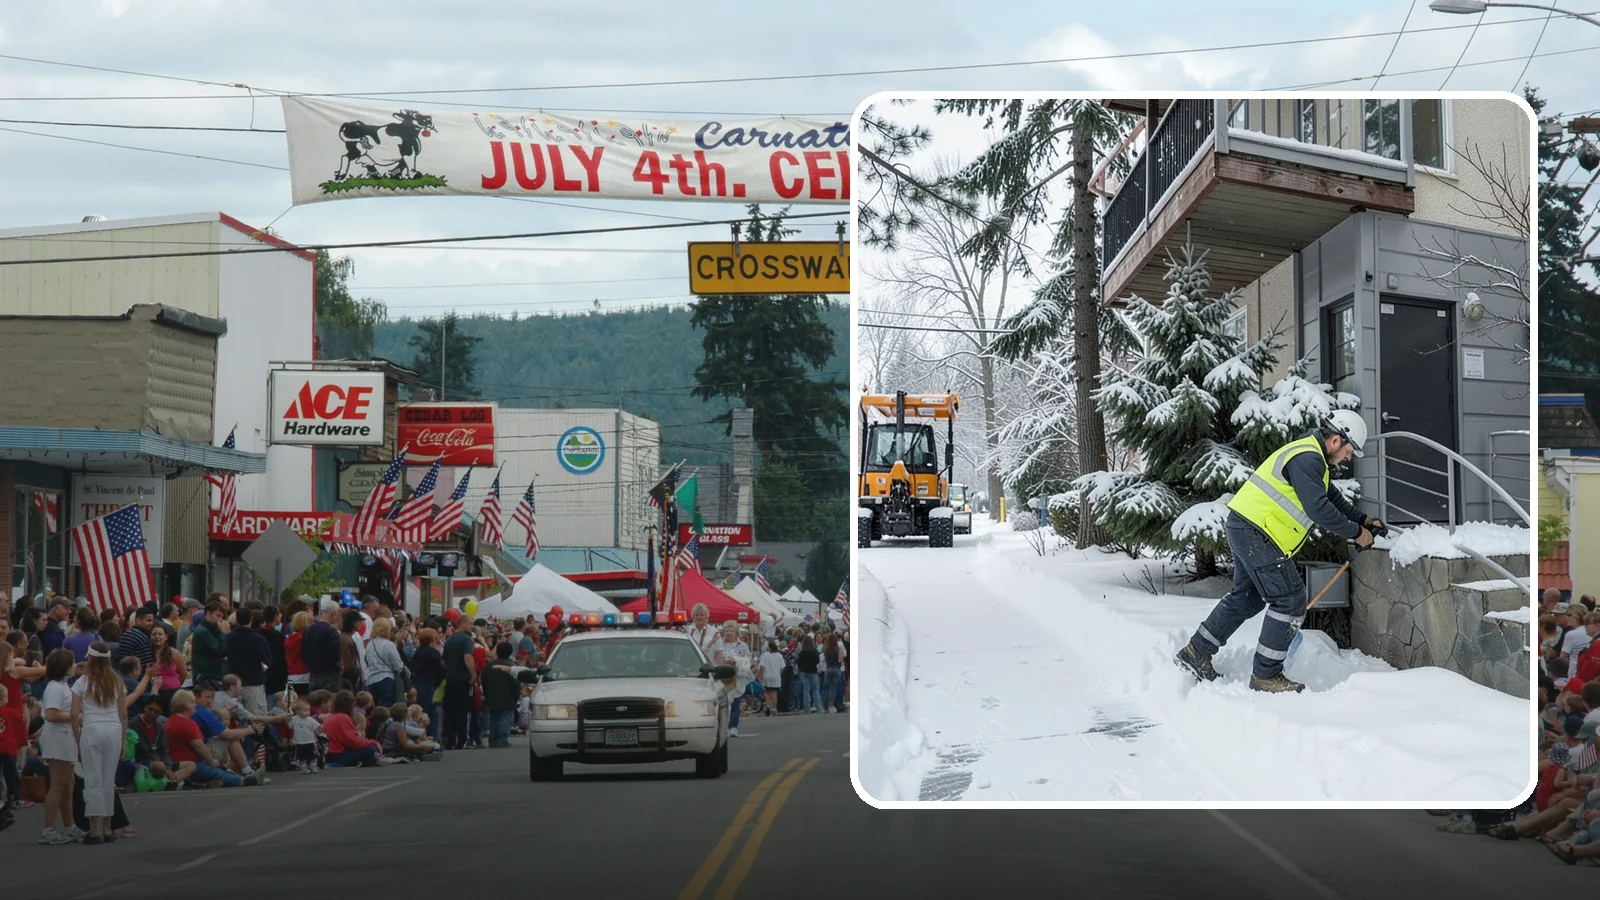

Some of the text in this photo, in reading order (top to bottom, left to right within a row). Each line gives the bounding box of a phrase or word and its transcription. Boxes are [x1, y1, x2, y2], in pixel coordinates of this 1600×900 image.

[481, 141, 604, 193] JULY
[632, 150, 746, 198] 4th.
[697, 254, 850, 280] CROSSWA
[283, 380, 374, 420] ACE
[406, 409, 485, 422] CEDAR LOG
[283, 421, 371, 436] Hardware
[416, 428, 476, 447] Coca-Cola
[96, 485, 124, 495] Vincent
[126, 485, 136, 495] de
[137, 486, 155, 495] Paul
[688, 526, 741, 535] CRNATION
[699, 535, 730, 543] GLASS
